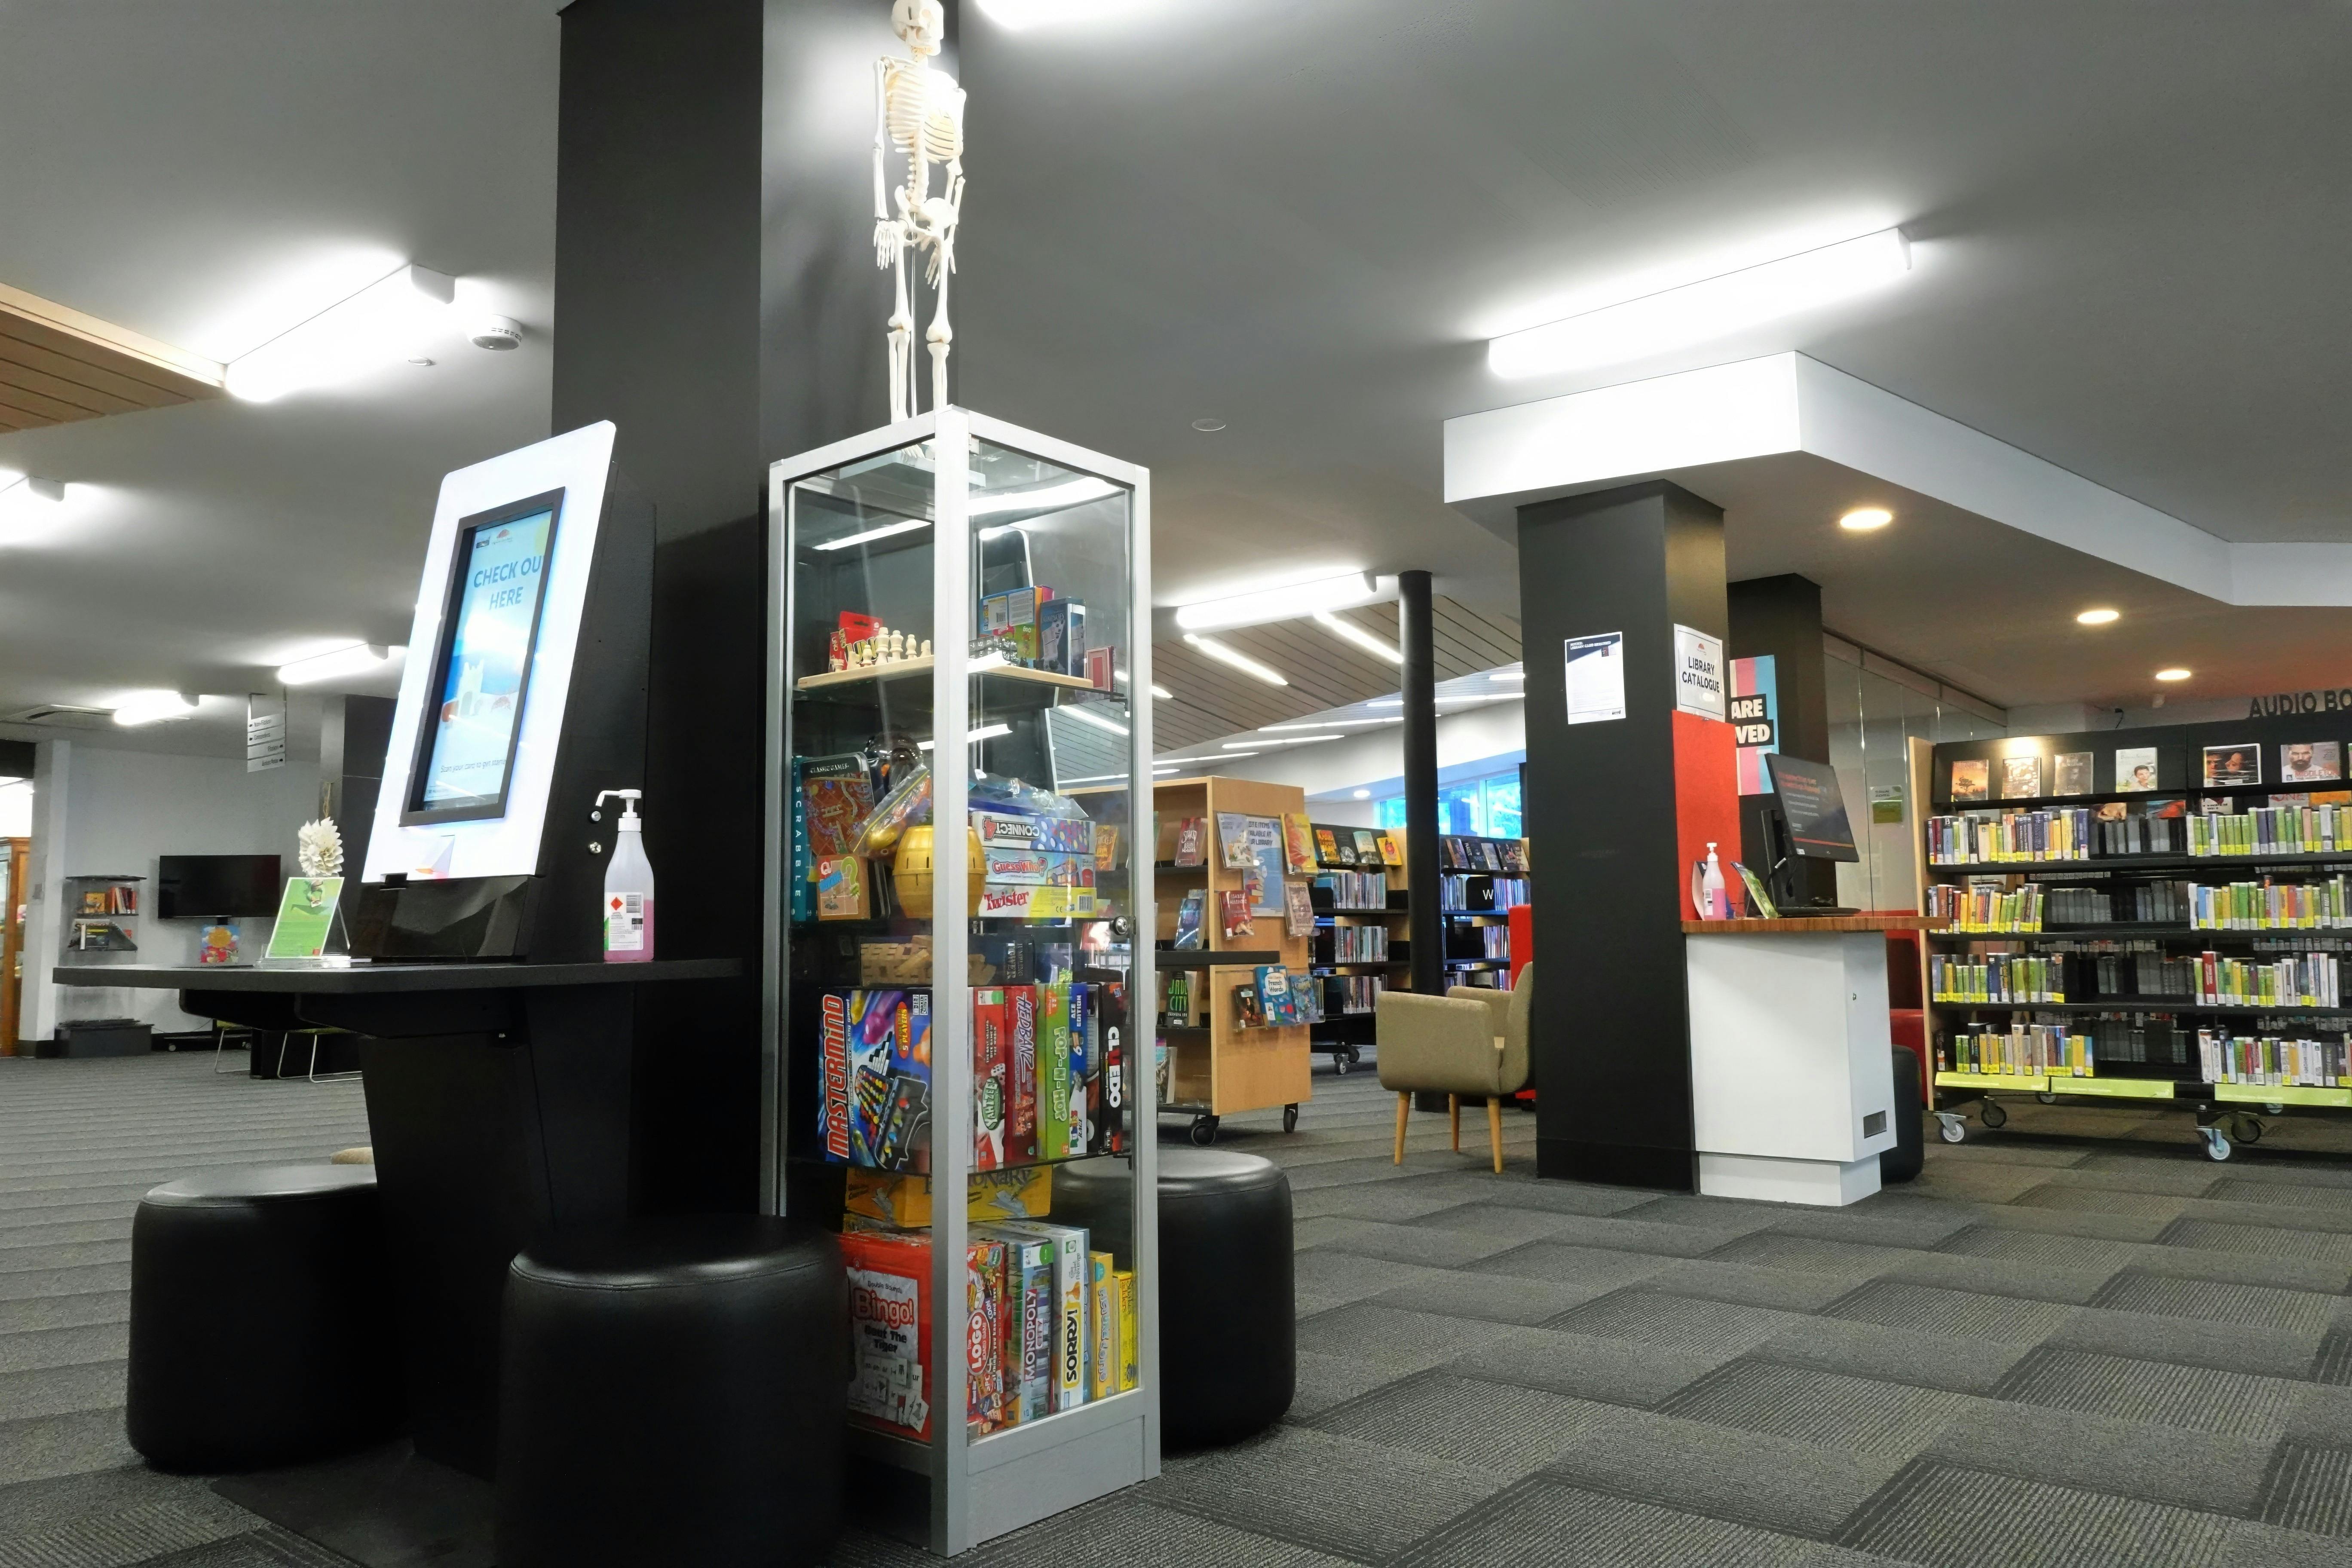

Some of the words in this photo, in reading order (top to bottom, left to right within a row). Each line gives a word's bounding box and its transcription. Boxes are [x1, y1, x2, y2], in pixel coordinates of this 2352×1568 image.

[474, 561, 518, 588] CHECK
[521, 555, 544, 576] OU
[489, 586, 524, 610] HERE
[1688, 656, 1715, 676] LIBRARY
[1682, 671, 1720, 693] CATALOGUE
[1731, 699, 1763, 719] ARE
[2246, 692, 2317, 719] AUDIO
[1735, 724, 1770, 744] VED
[984, 817, 997, 840] 4
[995, 822, 1039, 837] CONNECT
[984, 890, 1029, 911] Twister
[1482, 889, 1493, 900] W
[1007, 940, 1016, 979] TOWER
[1170, 995, 1187, 1011] CITY
[1016, 992, 1034, 1083] HEDBANZ
[823, 994, 849, 1159] MASTERMIND
[1051, 1026, 1067, 1121] POP-N-HOP
[1108, 1026, 1121, 1108] CLUEDO
[982, 1078, 998, 1127] YAHTZEE!
[854, 1289, 914, 1329] Bingo!
[873, 1339, 898, 1353] Tiger
[890, 1330, 907, 1343] The
[971, 1315, 982, 1369] LOGO
[1024, 1290, 1036, 1380] MONOPOLY
[1066, 1309, 1078, 1382] SORRY!
